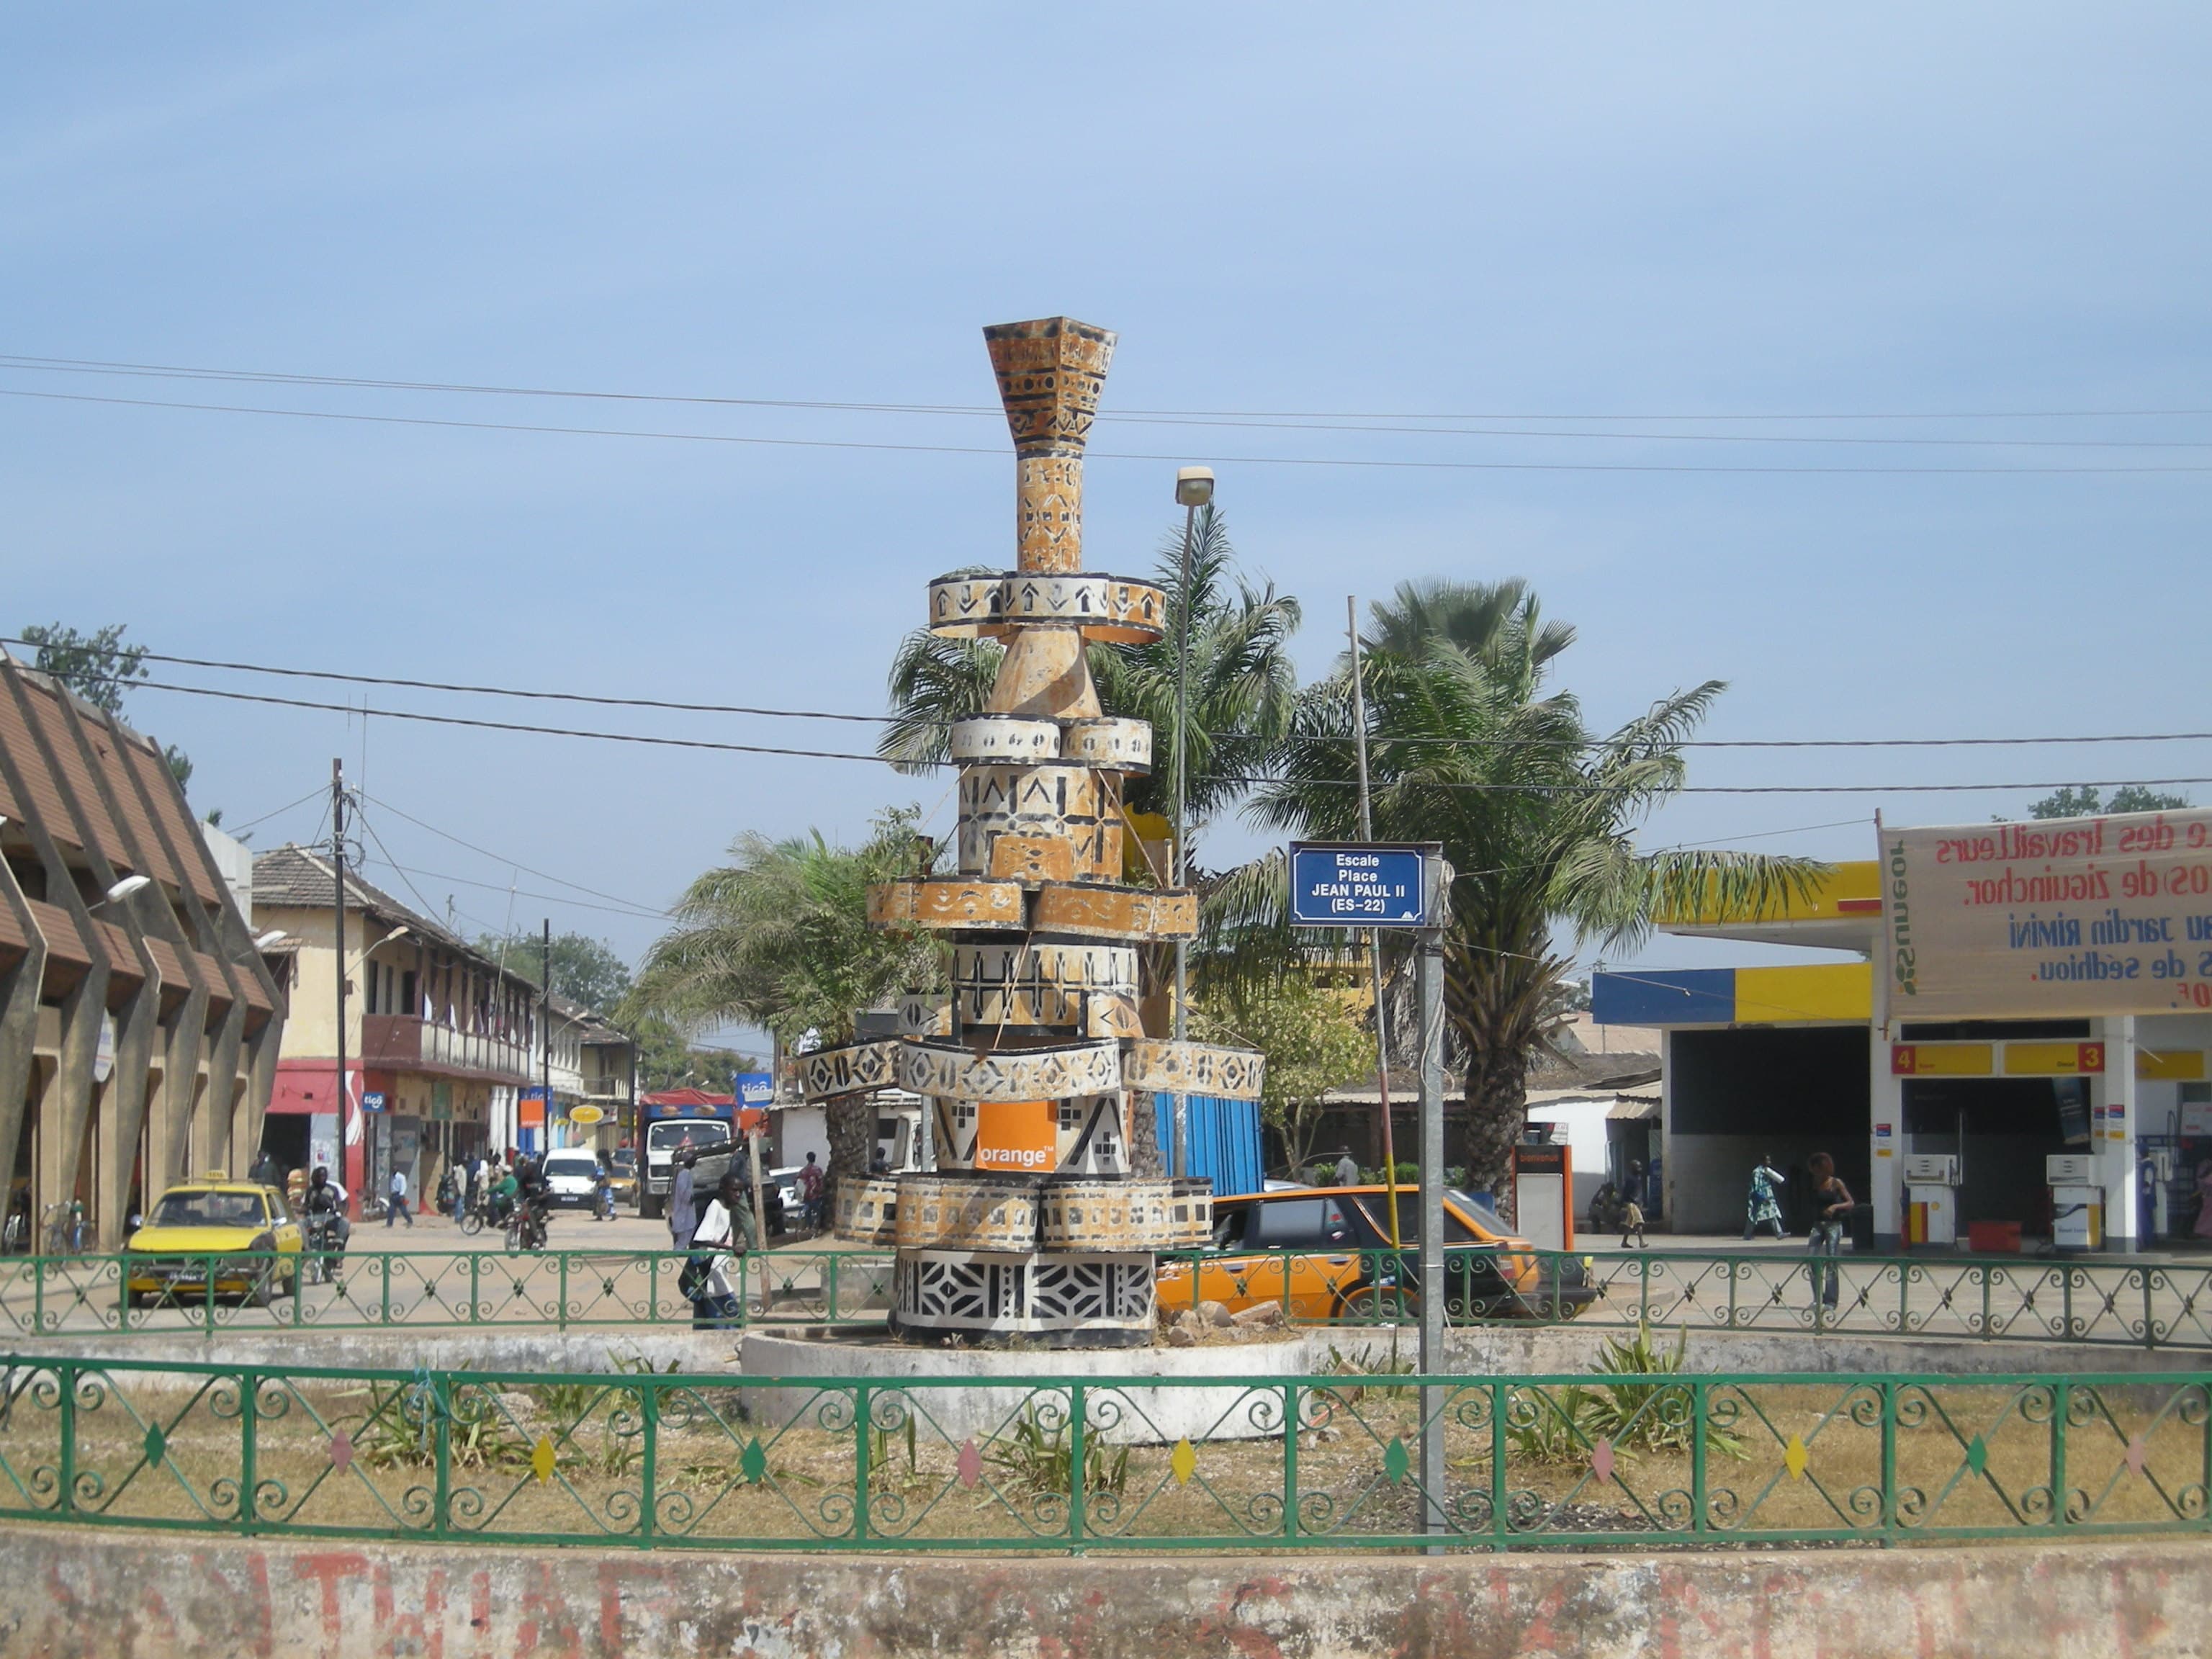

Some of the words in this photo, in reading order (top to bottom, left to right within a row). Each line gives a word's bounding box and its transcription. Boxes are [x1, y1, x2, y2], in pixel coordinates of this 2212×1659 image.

[1336, 853, 1380, 867] Escale
[1339, 869, 1377, 882] Place
[1311, 884, 1349, 896] JEAN
[1354, 884, 1390, 897] PAUL
[1395, 884, 1405, 897] II
[1331, 899, 1385, 914] (ES-22)
[1898, 1049, 1911, 1069] 4
[2085, 1047, 2099, 1067] 3
[980, 1147, 1047, 1167] orange
